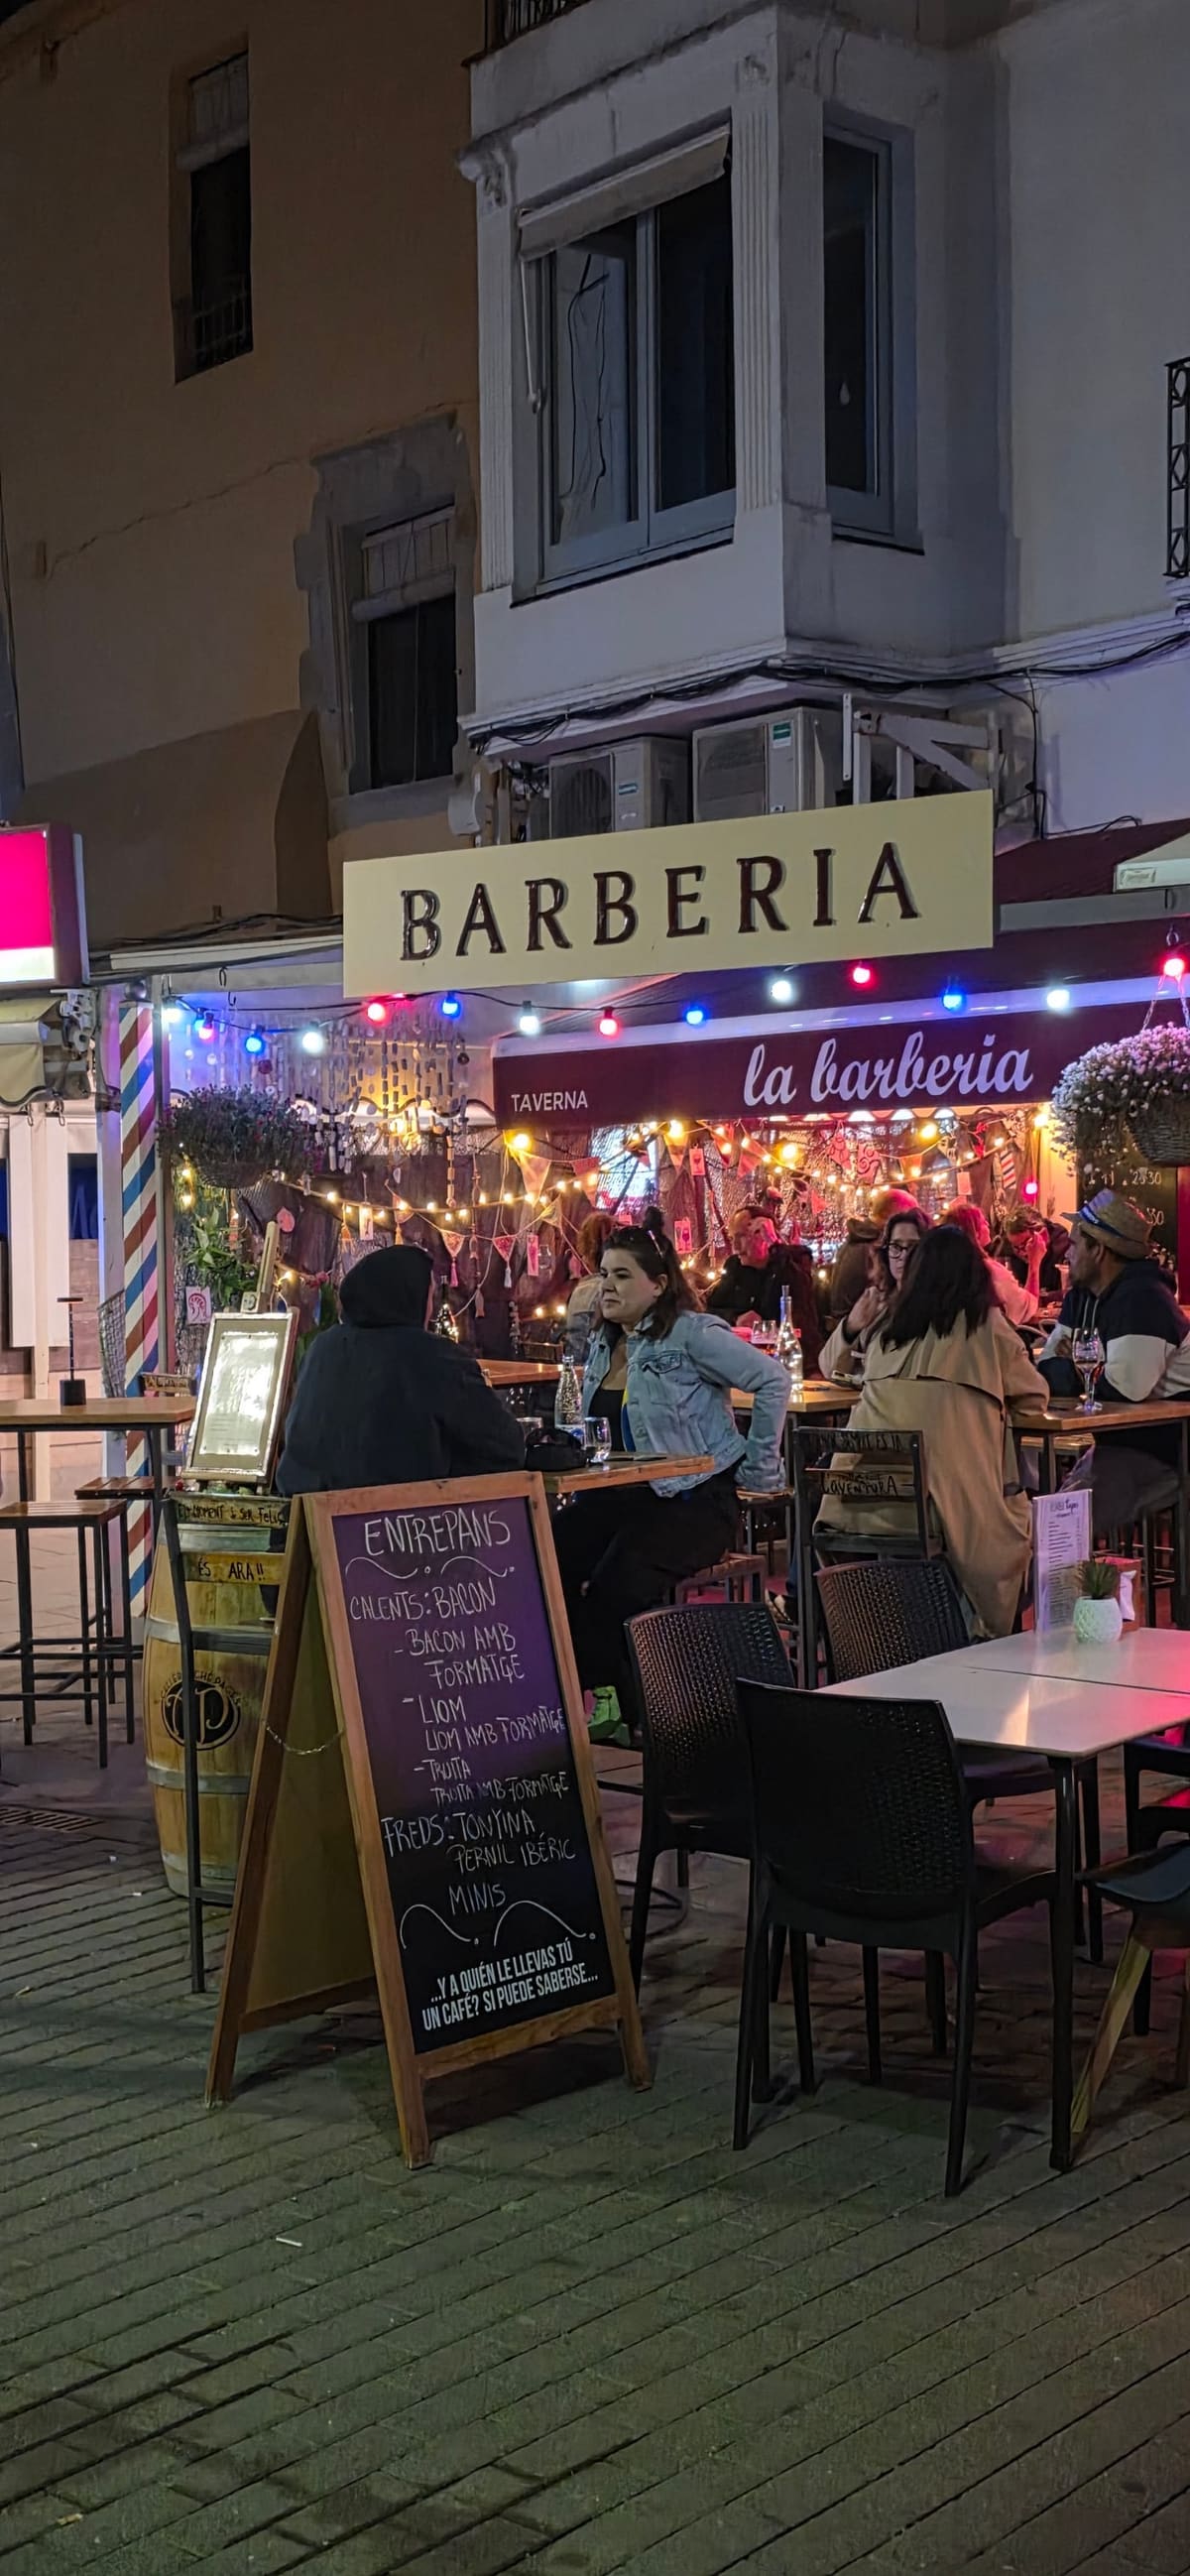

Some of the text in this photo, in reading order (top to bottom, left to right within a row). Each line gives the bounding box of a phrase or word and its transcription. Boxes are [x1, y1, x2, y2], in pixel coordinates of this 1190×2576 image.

[400, 841, 918, 961] BARBERIA
[744, 1031, 1034, 1107] la barberia
[511, 1090, 588, 1112] TAVERNA
[364, 1507, 511, 1556] ENTREPANS
[431, 1577, 496, 1619] BACON
[474, 1622, 516, 1653] AMB
[423, 1654, 524, 1689] FORMATGE
[465, 1722, 498, 1747] AMB
[452, 1808, 536, 1842] TONYINA
[446, 1832, 576, 1875] PERNIL IBÉRIC
[448, 1883, 506, 1915] MINIS
[449, 1973, 460, 1997] A
[459, 1962, 496, 1992] QUIÉN
[496, 1958, 512, 1983] LE
[513, 1945, 556, 1978] LLEVAS
[556, 1937, 573, 1965] TÚ
[421, 1962, 599, 2031] UN CAFÉ? SI PUEDE SABERSE...
